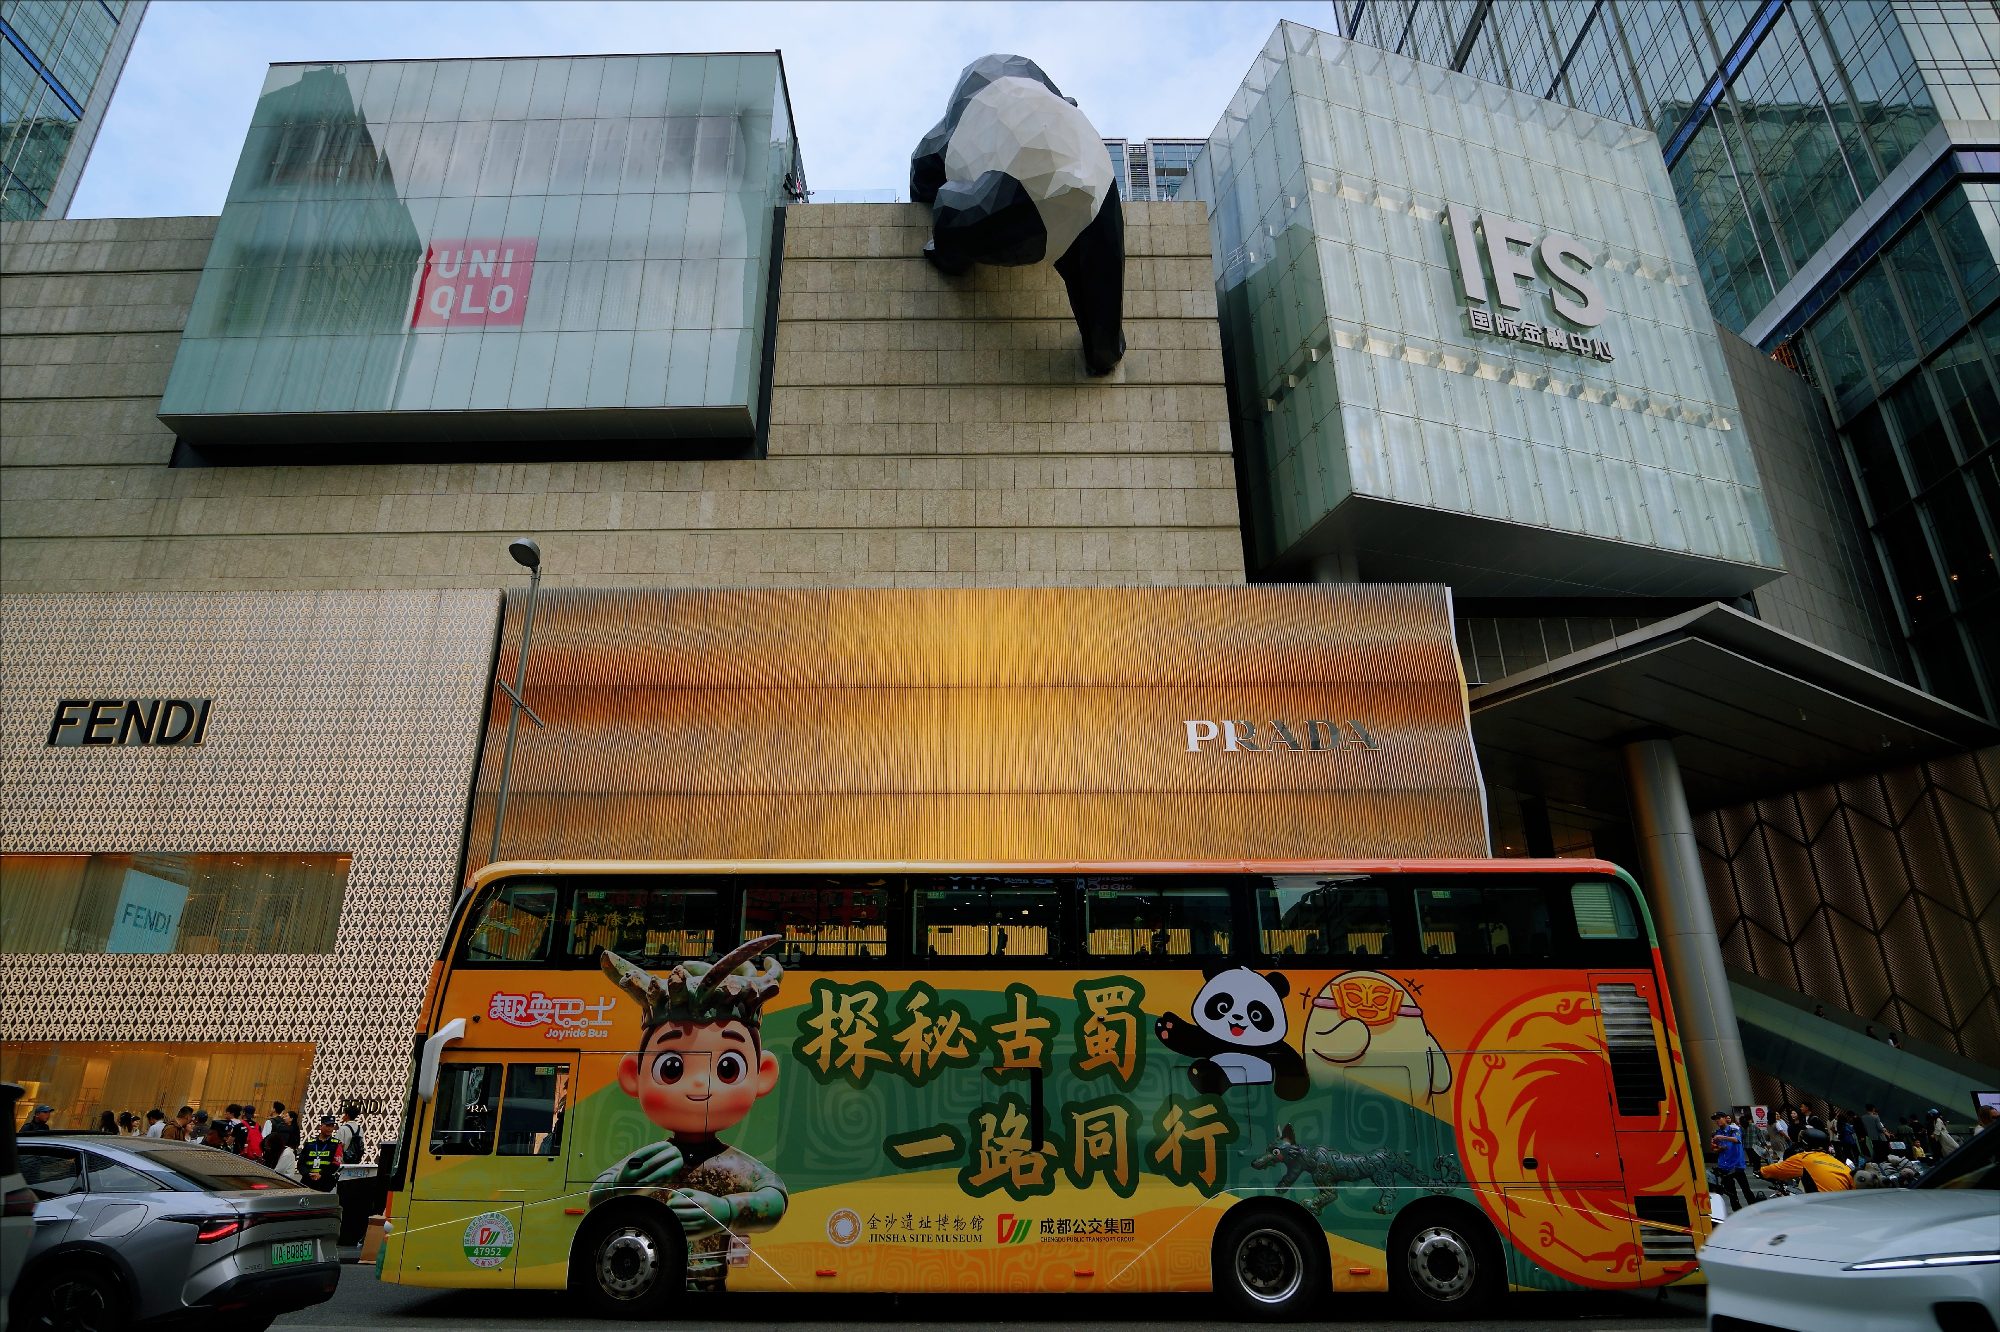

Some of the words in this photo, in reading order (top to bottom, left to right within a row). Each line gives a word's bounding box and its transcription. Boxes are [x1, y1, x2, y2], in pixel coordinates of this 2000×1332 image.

[437, 249, 515, 279] UNI
[1445, 203, 1608, 328] IFS
[430, 284, 514, 320] QLO
[1465, 306, 1615, 363] 国际金融中心
[48, 699, 213, 746] FENDI
[1183, 719, 1382, 752] PRADA
[121, 902, 172, 935] FENDI
[545, 1027, 587, 1040] Joyride
[587, 1028, 608, 1038] Bus
[800, 983, 1140, 1084] 探秘古蜀
[892, 1102, 1230, 1190] 一路同行
[868, 1234, 907, 1243] JINSHA
[909, 1234, 934, 1243] SITE
[935, 1234, 983, 1243] MUSEUM
[1040, 1218, 1135, 1234] 成都公交集团
[473, 1247, 502, 1256] 47952
